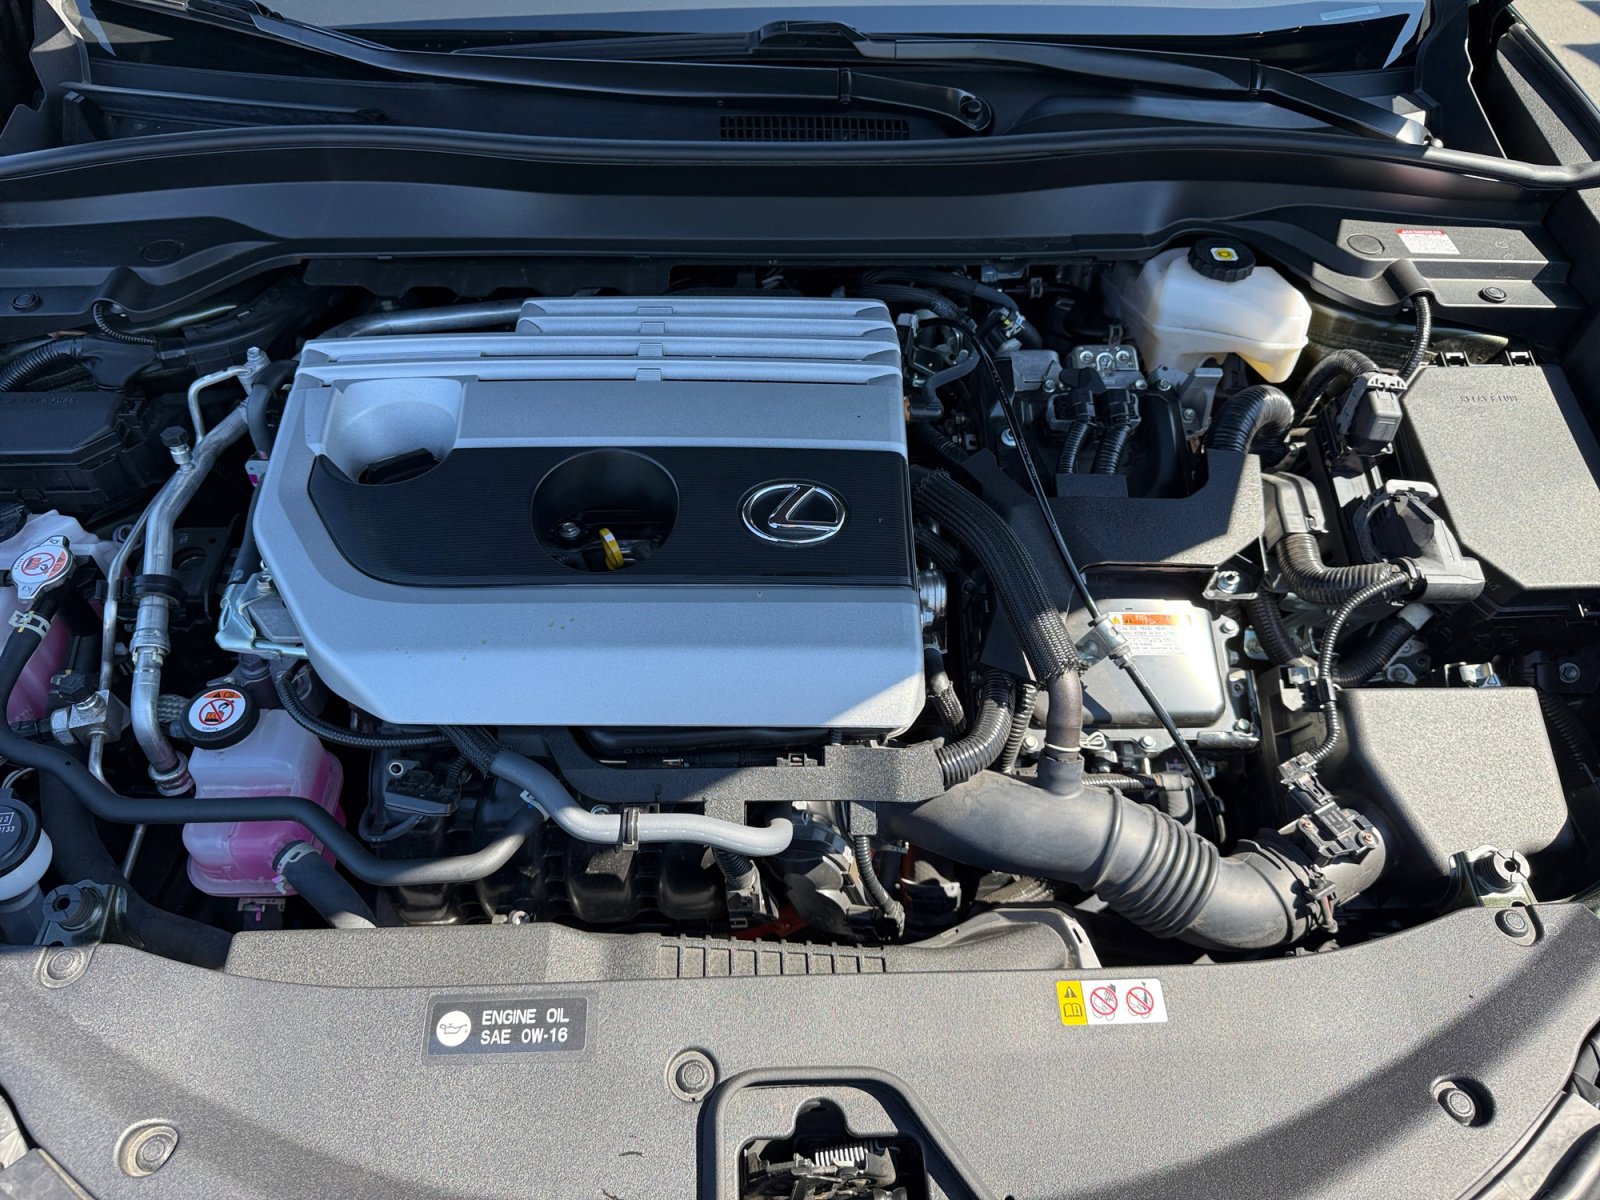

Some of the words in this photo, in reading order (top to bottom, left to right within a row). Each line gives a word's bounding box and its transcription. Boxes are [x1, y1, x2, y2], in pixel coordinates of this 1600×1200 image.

[481, 1008, 537, 1026] ENGINE
[546, 1007, 570, 1023] OIL
[480, 1028, 511, 1045] SAE
[521, 1027, 568, 1044] 0W-16
